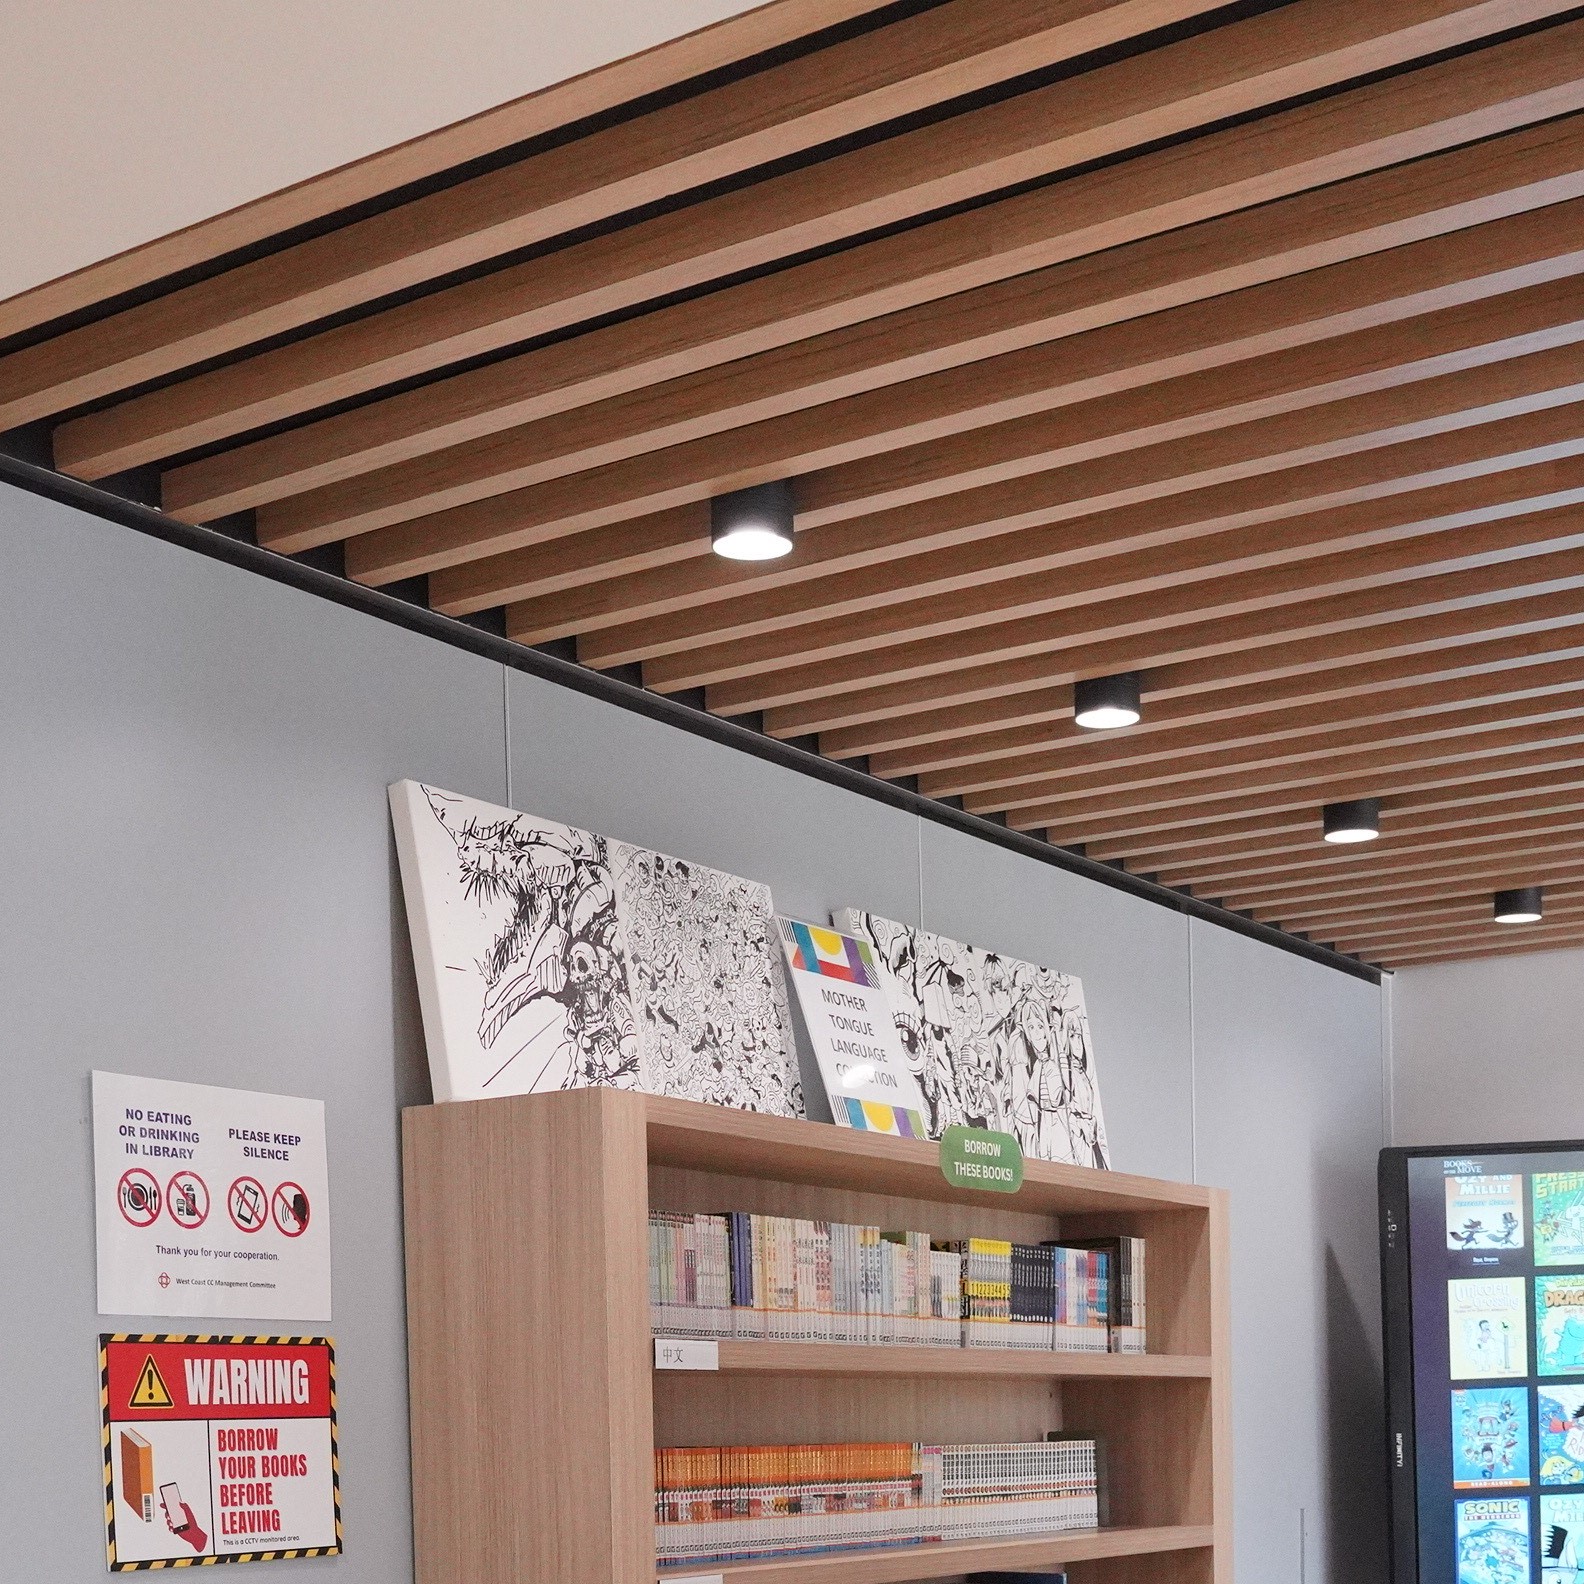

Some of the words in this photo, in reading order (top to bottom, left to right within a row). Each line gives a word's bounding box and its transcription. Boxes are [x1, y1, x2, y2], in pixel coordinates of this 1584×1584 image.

[821, 988, 867, 1012] MOTHER
[829, 1013, 874, 1037] TONGUE
[830, 1037, 888, 1063] LANGUAGE
[125, 1108, 143, 1121] NO
[147, 1110, 192, 1126] EATING
[119, 1125, 136, 1137] OR
[139, 1127, 200, 1144] DRINKING
[228, 1128, 270, 1144] PLEASE
[273, 1133, 302, 1147] KEEP
[125, 1142, 138, 1155] IN
[142, 1144, 194, 1160] LIBRARY
[243, 1146, 290, 1162] SILENCE
[964, 1139, 1001, 1157] BORROW
[954, 1162, 981, 1178] THESE
[983, 1165, 1013, 1182] BOOKS!
[156, 1245, 181, 1255] Thank
[183, 1247, 199, 1258] you
[201, 1247, 212, 1257] for
[214, 1250, 231, 1259] your
[233, 1250, 280, 1261] cooperation.
[215, 1280, 248, 1288] Management
[249, 1281, 276, 1289] Committee
[662, 1347, 684, 1363] 中文
[184, 1358, 310, 1406] WARNING
[217, 1428, 279, 1452] BORROW
[218, 1455, 256, 1479] YOUR
[261, 1454, 308, 1478] BOOKS
[219, 1482, 273, 1508] BEFORE
[1464, 1500, 1520, 1515] SONIC
[221, 1509, 281, 1535] LEAVING
